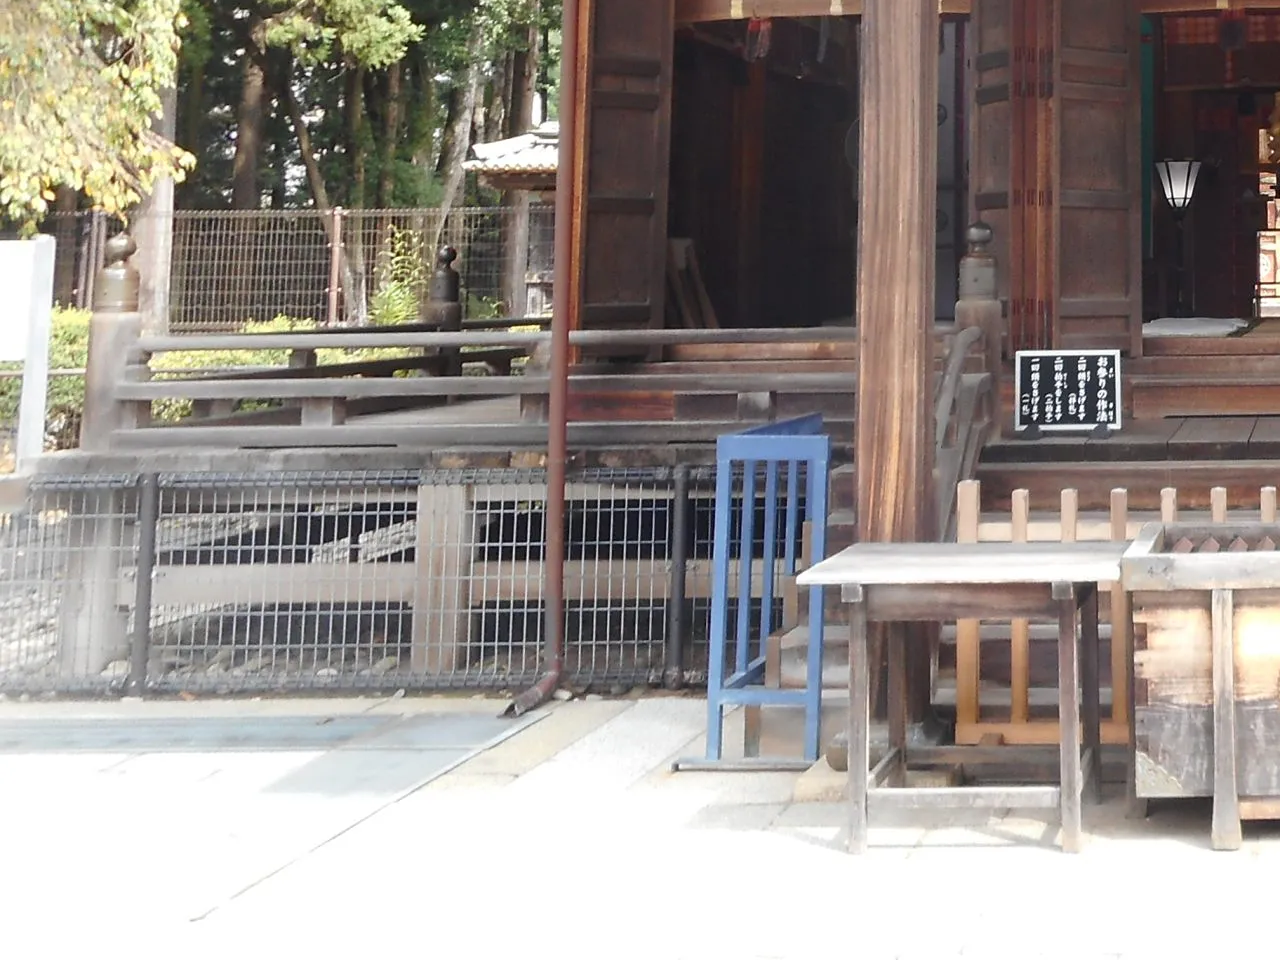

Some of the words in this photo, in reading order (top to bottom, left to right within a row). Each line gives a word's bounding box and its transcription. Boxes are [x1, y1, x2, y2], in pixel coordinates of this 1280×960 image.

[1096, 356, 1108, 422] お参りの作法
